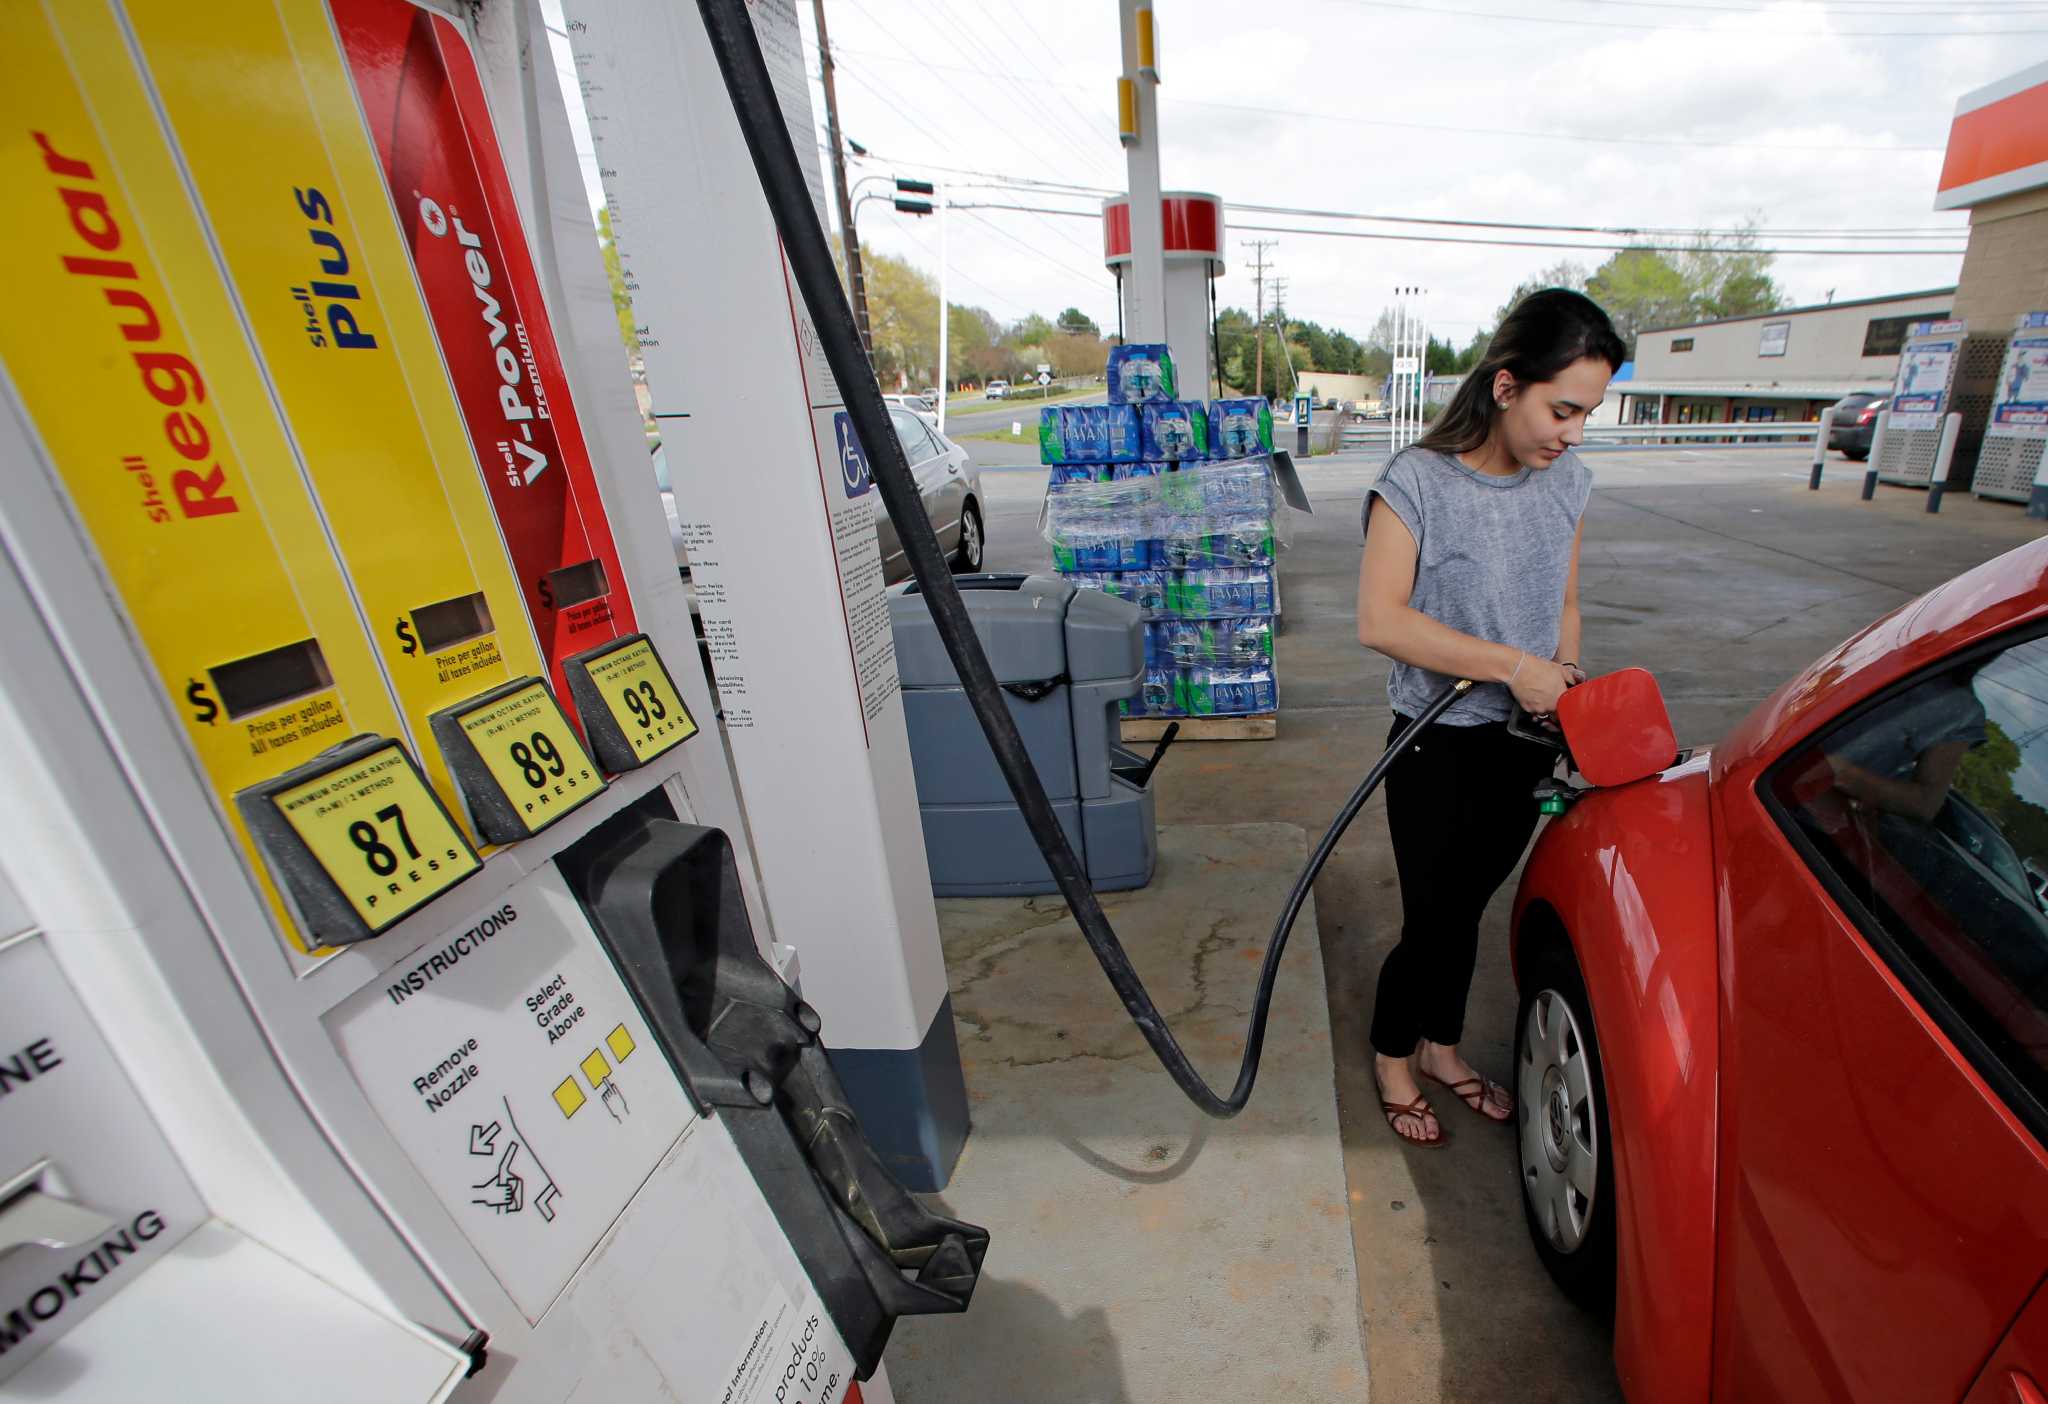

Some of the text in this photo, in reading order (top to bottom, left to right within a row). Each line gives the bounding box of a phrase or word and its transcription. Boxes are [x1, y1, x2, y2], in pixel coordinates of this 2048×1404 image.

[292, 185, 378, 349] Plus
[31, 130, 240, 519] Regular
[290, 287, 327, 348] Shell
[515, 323, 550, 420] Premium
[122, 455, 172, 523] Shell
[497, 441, 521, 488] Shell
[395, 616, 417, 658] $
[436, 640, 496, 668] Price per gallon
[438, 650, 502, 684] All taxes included
[186, 677, 218, 726] $
[247, 699, 334, 738] Price per gallon
[466, 691, 546, 731] MINIMUM OCTANE RATING
[623, 680, 666, 729] 93
[252, 711, 344, 756] All taxes included
[636, 716, 684, 748] PRESS
[286, 756, 402, 811] MINIMUM OCTANE RATING
[510, 731, 565, 789] 89
[358, 776, 395, 797] METHOD
[525, 769, 590, 814] PRESS
[348, 803, 422, 876] 87
[366, 849, 458, 908] PRESS
[386, 903, 517, 1005] INSTRUCTIONS
[526, 973, 567, 1012] Select
[536, 990, 574, 1028] Grade
[547, 1005, 585, 1045] Above
[0, 1037, 63, 1096] NE
[413, 1037, 478, 1096] Remove
[425, 1062, 479, 1113] Nozzle
[0, 1210, 167, 1356] MOKING
[731, 1320, 769, 1387] Information
[775, 1314, 819, 1404] products
[800, 1344, 826, 1393] 10%
